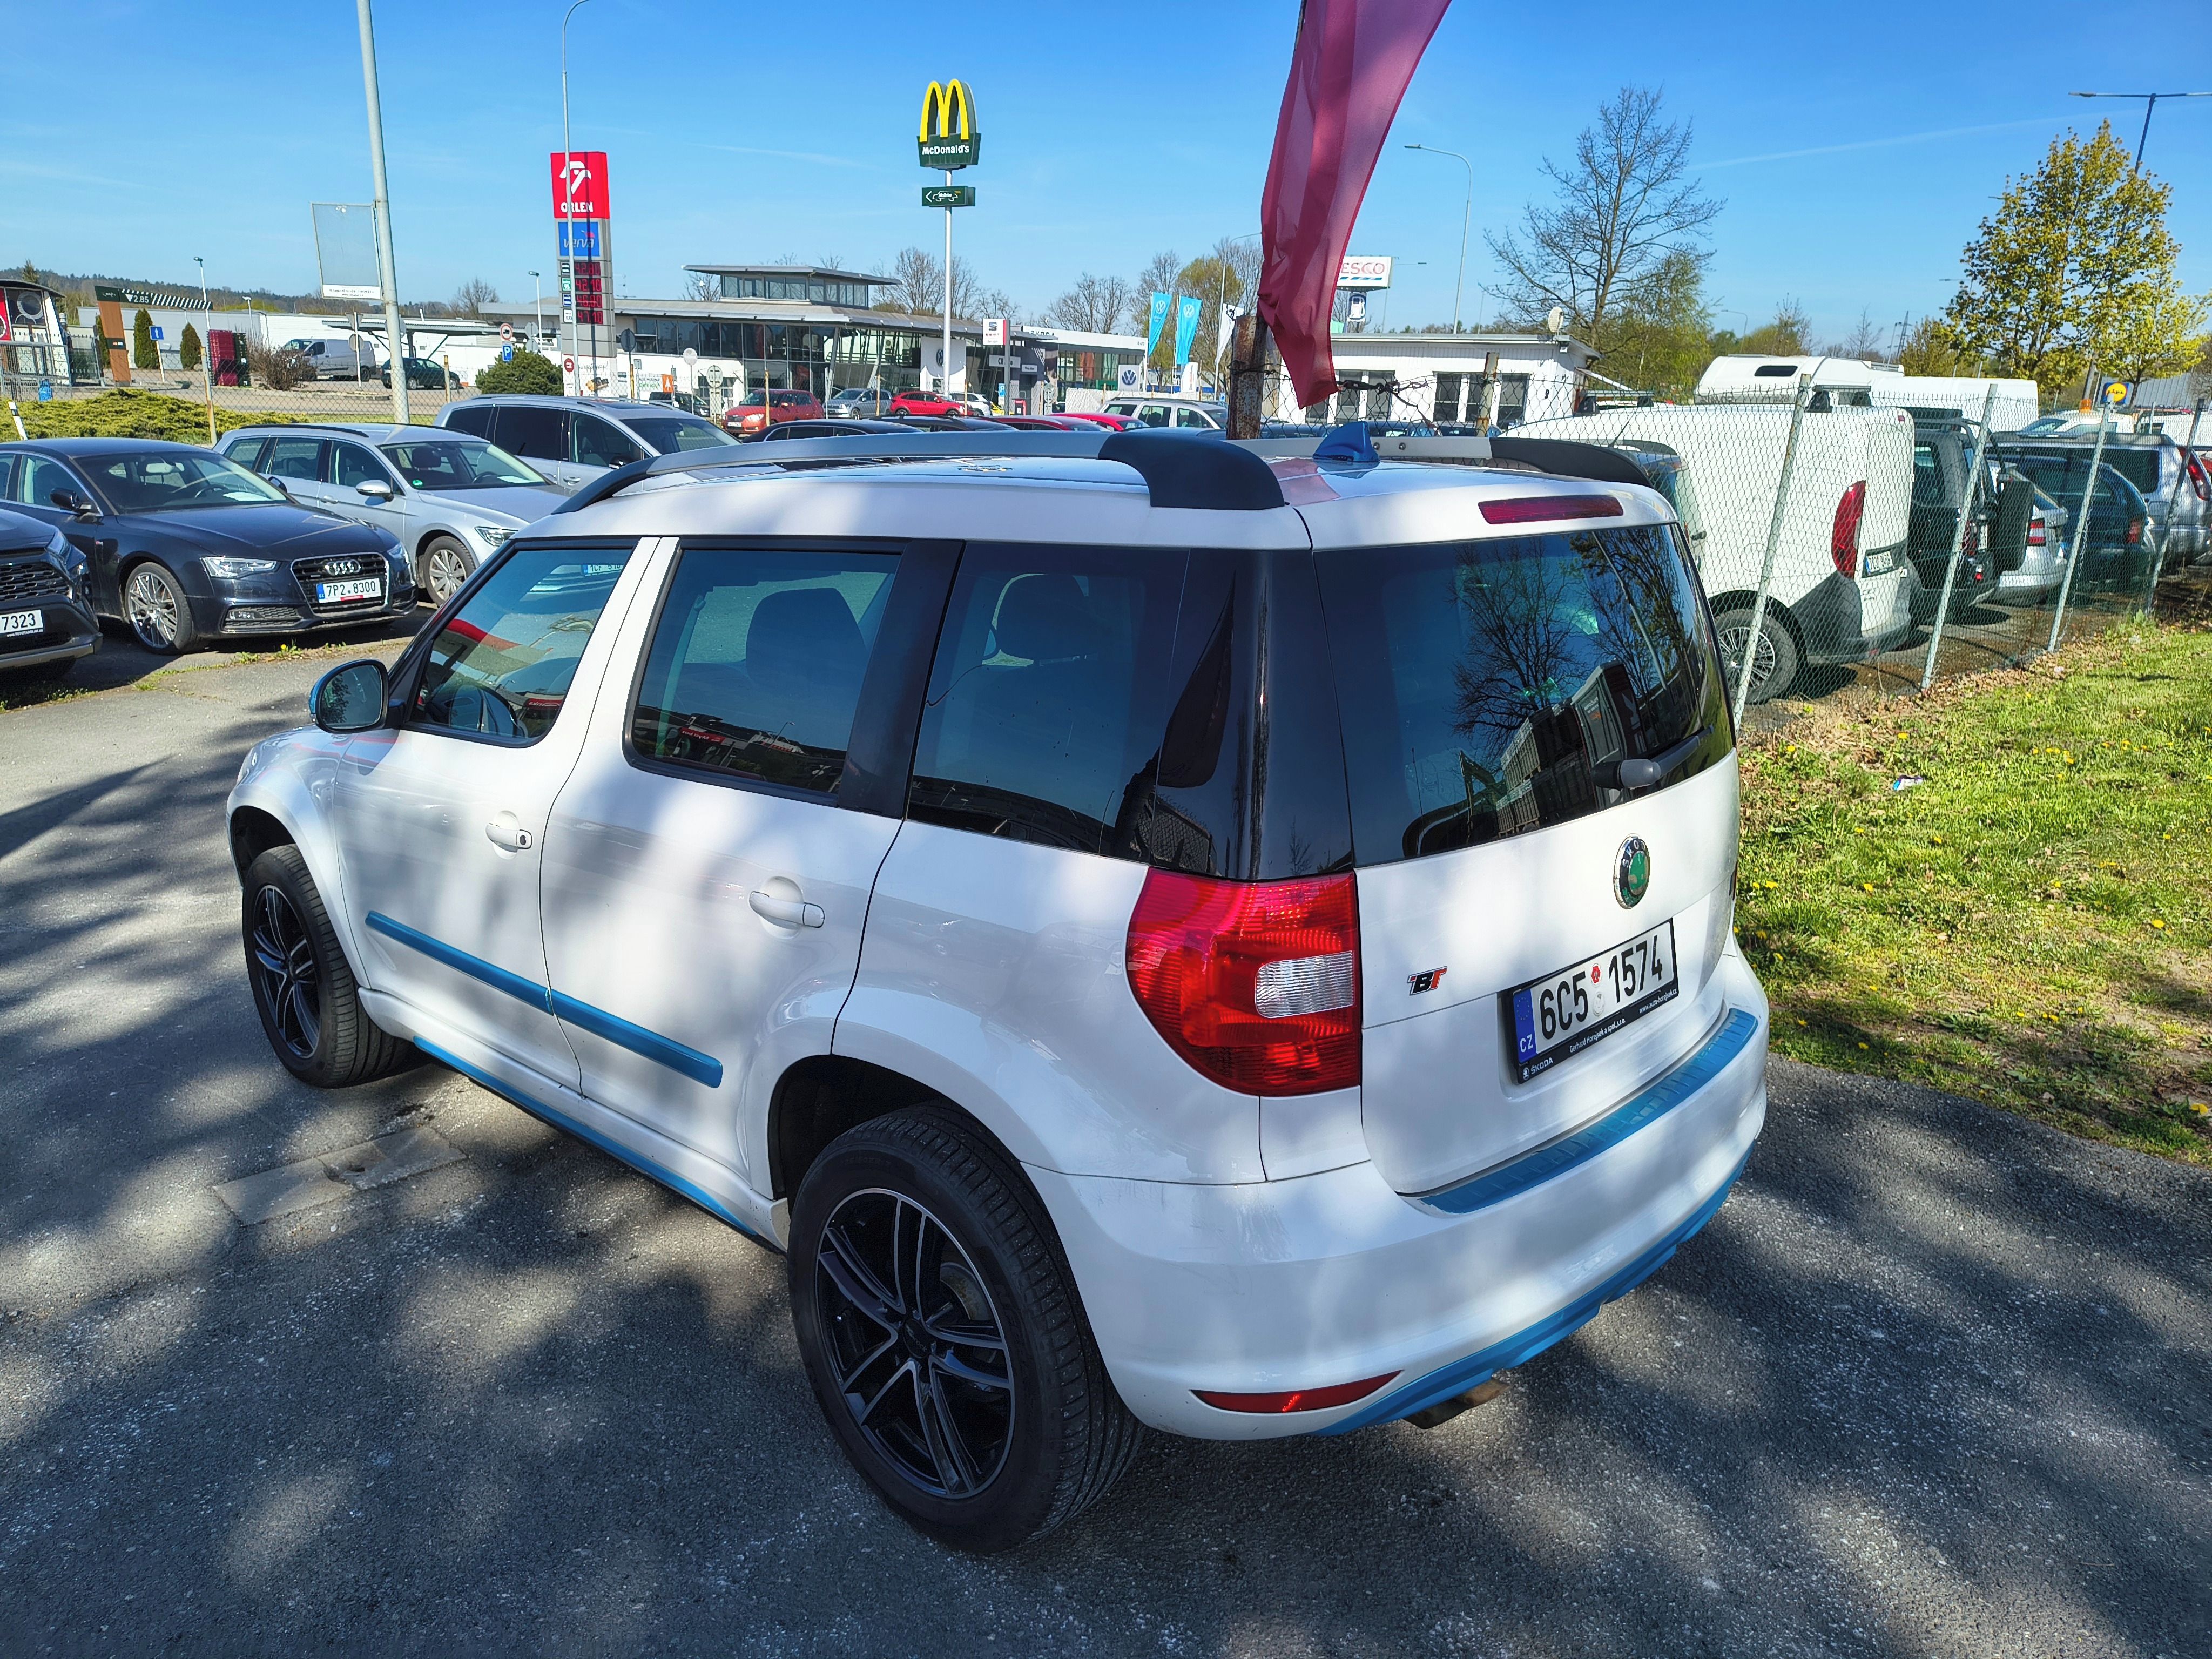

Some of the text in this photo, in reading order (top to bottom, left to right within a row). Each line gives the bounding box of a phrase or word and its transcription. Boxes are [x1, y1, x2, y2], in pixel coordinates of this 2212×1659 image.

[922, 144, 970, 156] McDonald's
[1340, 262, 1385, 274] ESCO
[133, 295, 149, 304] 2.85
[504, 346, 510, 356] P
[326, 581, 376, 597] 7P2 8300
[1, 613, 36, 631] 7323
[1540, 935, 1663, 1040] 6C5 1574
[1639, 988, 1677, 1014] www.auto-horejsek.cz
[1520, 1034, 1534, 1053] CZ
[1569, 1037, 1586, 1053] Gerhard
[1530, 1057, 1554, 1075] ŠKODA
